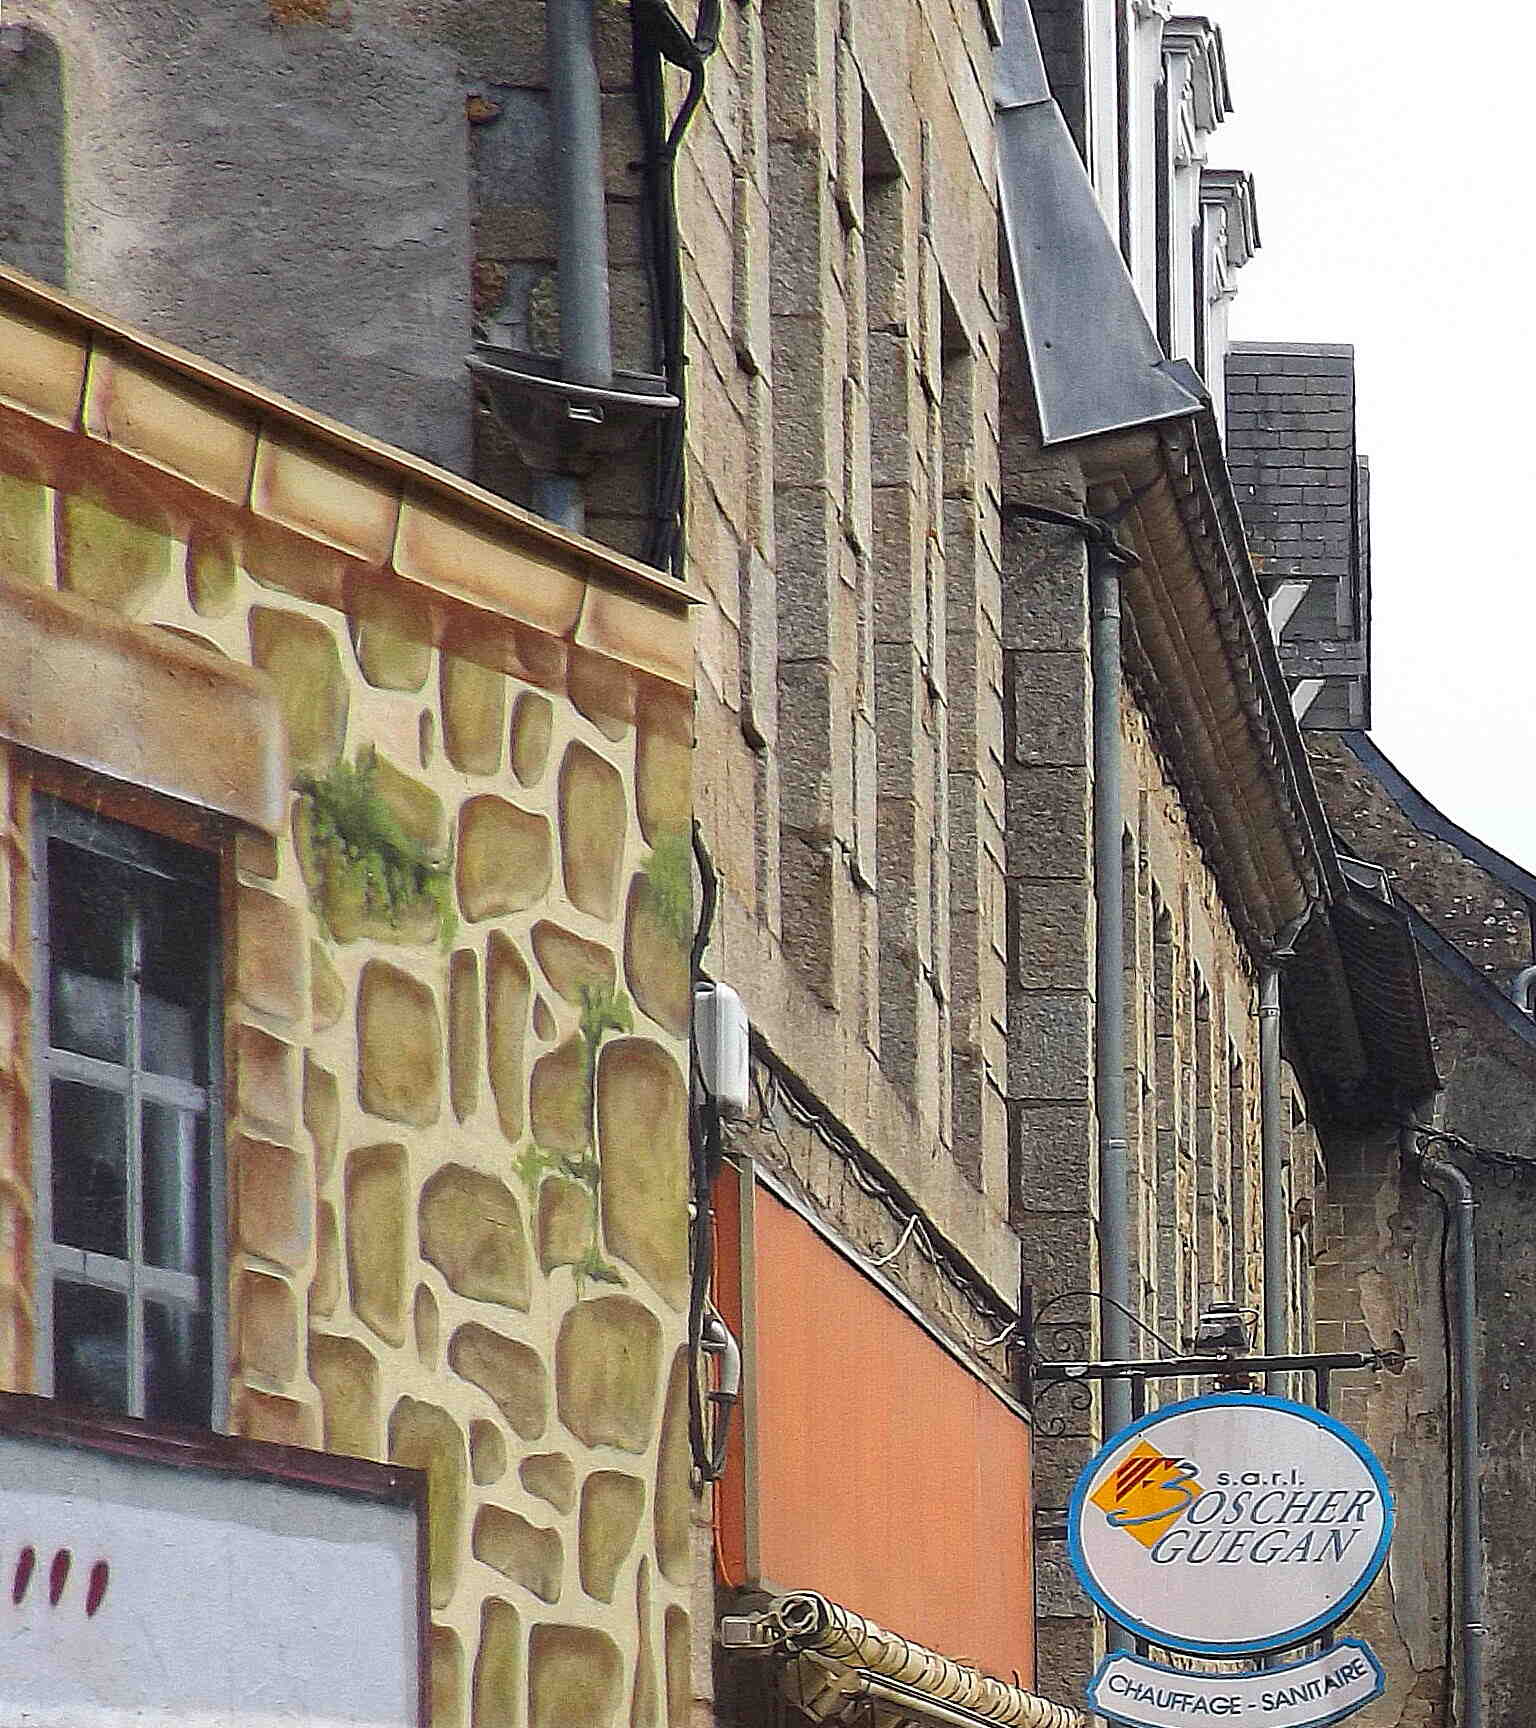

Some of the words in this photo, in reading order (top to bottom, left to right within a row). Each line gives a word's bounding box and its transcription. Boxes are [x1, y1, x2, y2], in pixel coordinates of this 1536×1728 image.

[1105, 1457, 1378, 1528] BOSCHER
[1217, 1468, 1305, 1487] s.a.r.l.
[1151, 1528, 1362, 1565] GUEGAN
[1107, 1673, 1242, 1716] CHAUFFAGE
[1261, 1659, 1369, 1712] SANITAIRE
